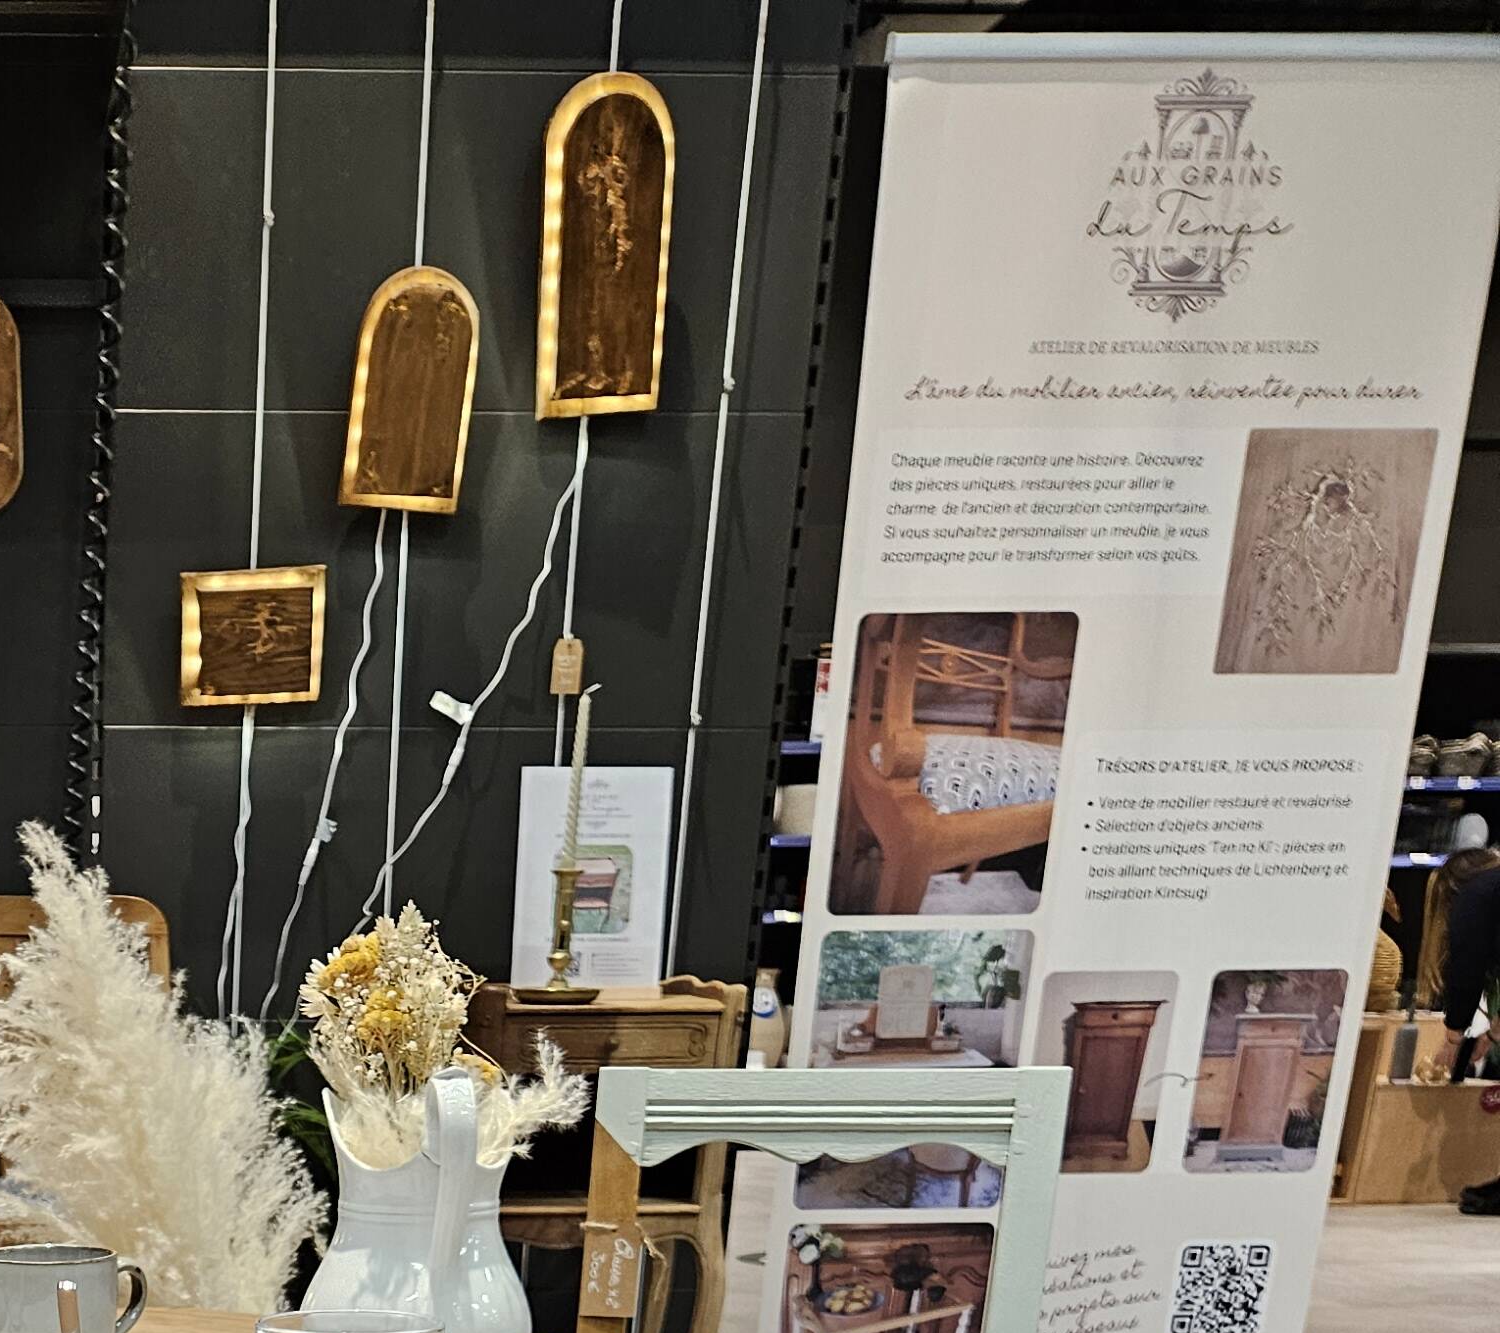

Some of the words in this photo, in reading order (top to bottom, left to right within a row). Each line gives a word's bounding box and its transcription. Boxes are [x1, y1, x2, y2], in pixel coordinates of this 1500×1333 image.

[1109, 165, 1166, 187] AUX
[1180, 165, 1284, 187] GRAINS
[1086, 200, 1152, 238] du
[1155, 188, 1295, 254] Temps
[1028, 340, 1086, 354] ATELIER
[1088, 340, 1108, 354] DE
[1110, 340, 1228, 354] REVALORISATION
[1232, 340, 1252, 354] DE
[1256, 340, 1319, 354] MEUBLES
[975, 376, 1004, 398] du
[1010, 374, 1102, 399] mobilier
[1294, 385, 1349, 409] pour
[1355, 375, 1423, 399] durer
[891, 453, 941, 468] Chaque
[943, 454, 994, 467] meuble
[996, 454, 1047, 467] raconte
[1049, 455, 1074, 467] une
[889, 477, 913, 491] des
[1094, 479, 1125, 493] pour
[1162, 476, 1176, 490] le
[885, 502, 937, 515] charme
[941, 501, 959, 515] de
[1014, 502, 1028, 514] et
[883, 524, 895, 539] Si
[899, 527, 929, 539] vous
[932, 525, 998, 539] souhaitez
[999, 525, 1085, 541] personnaliser
[1090, 527, 1107, 538] un
[1163, 524, 1177, 541] je
[1179, 527, 1210, 538] vous
[880, 550, 965, 564] accompagne
[967, 550, 999, 564] pour
[1001, 548, 1013, 561] le
[1016, 548, 1092, 561] transformer
[1097, 548, 1133, 561] selon
[1135, 550, 1157, 561] vos
[1235, 759, 1249, 773] JE
[1252, 759, 1290, 773] VOUS
[1099, 796, 1137, 809] Vente
[1139, 796, 1155, 809] de
[1157, 795, 1210, 809] mobilier
[1272, 796, 1286, 808] et
[1212, 818, 1264, 832] anciens
[1153, 841, 1207, 856] uniques
[1327, 841, 1346, 854] en
[1088, 864, 1116, 878] bois
[1158, 863, 1233, 878] techniques
[1235, 863, 1252, 876] de
[1253, 862, 1331, 878] Lichtenberg
[1333, 863, 1349, 876] et
[1085, 886, 1153, 901] inspiration
[1155, 886, 1209, 901] Kintsugi
[1120, 1258, 1146, 1280] et
